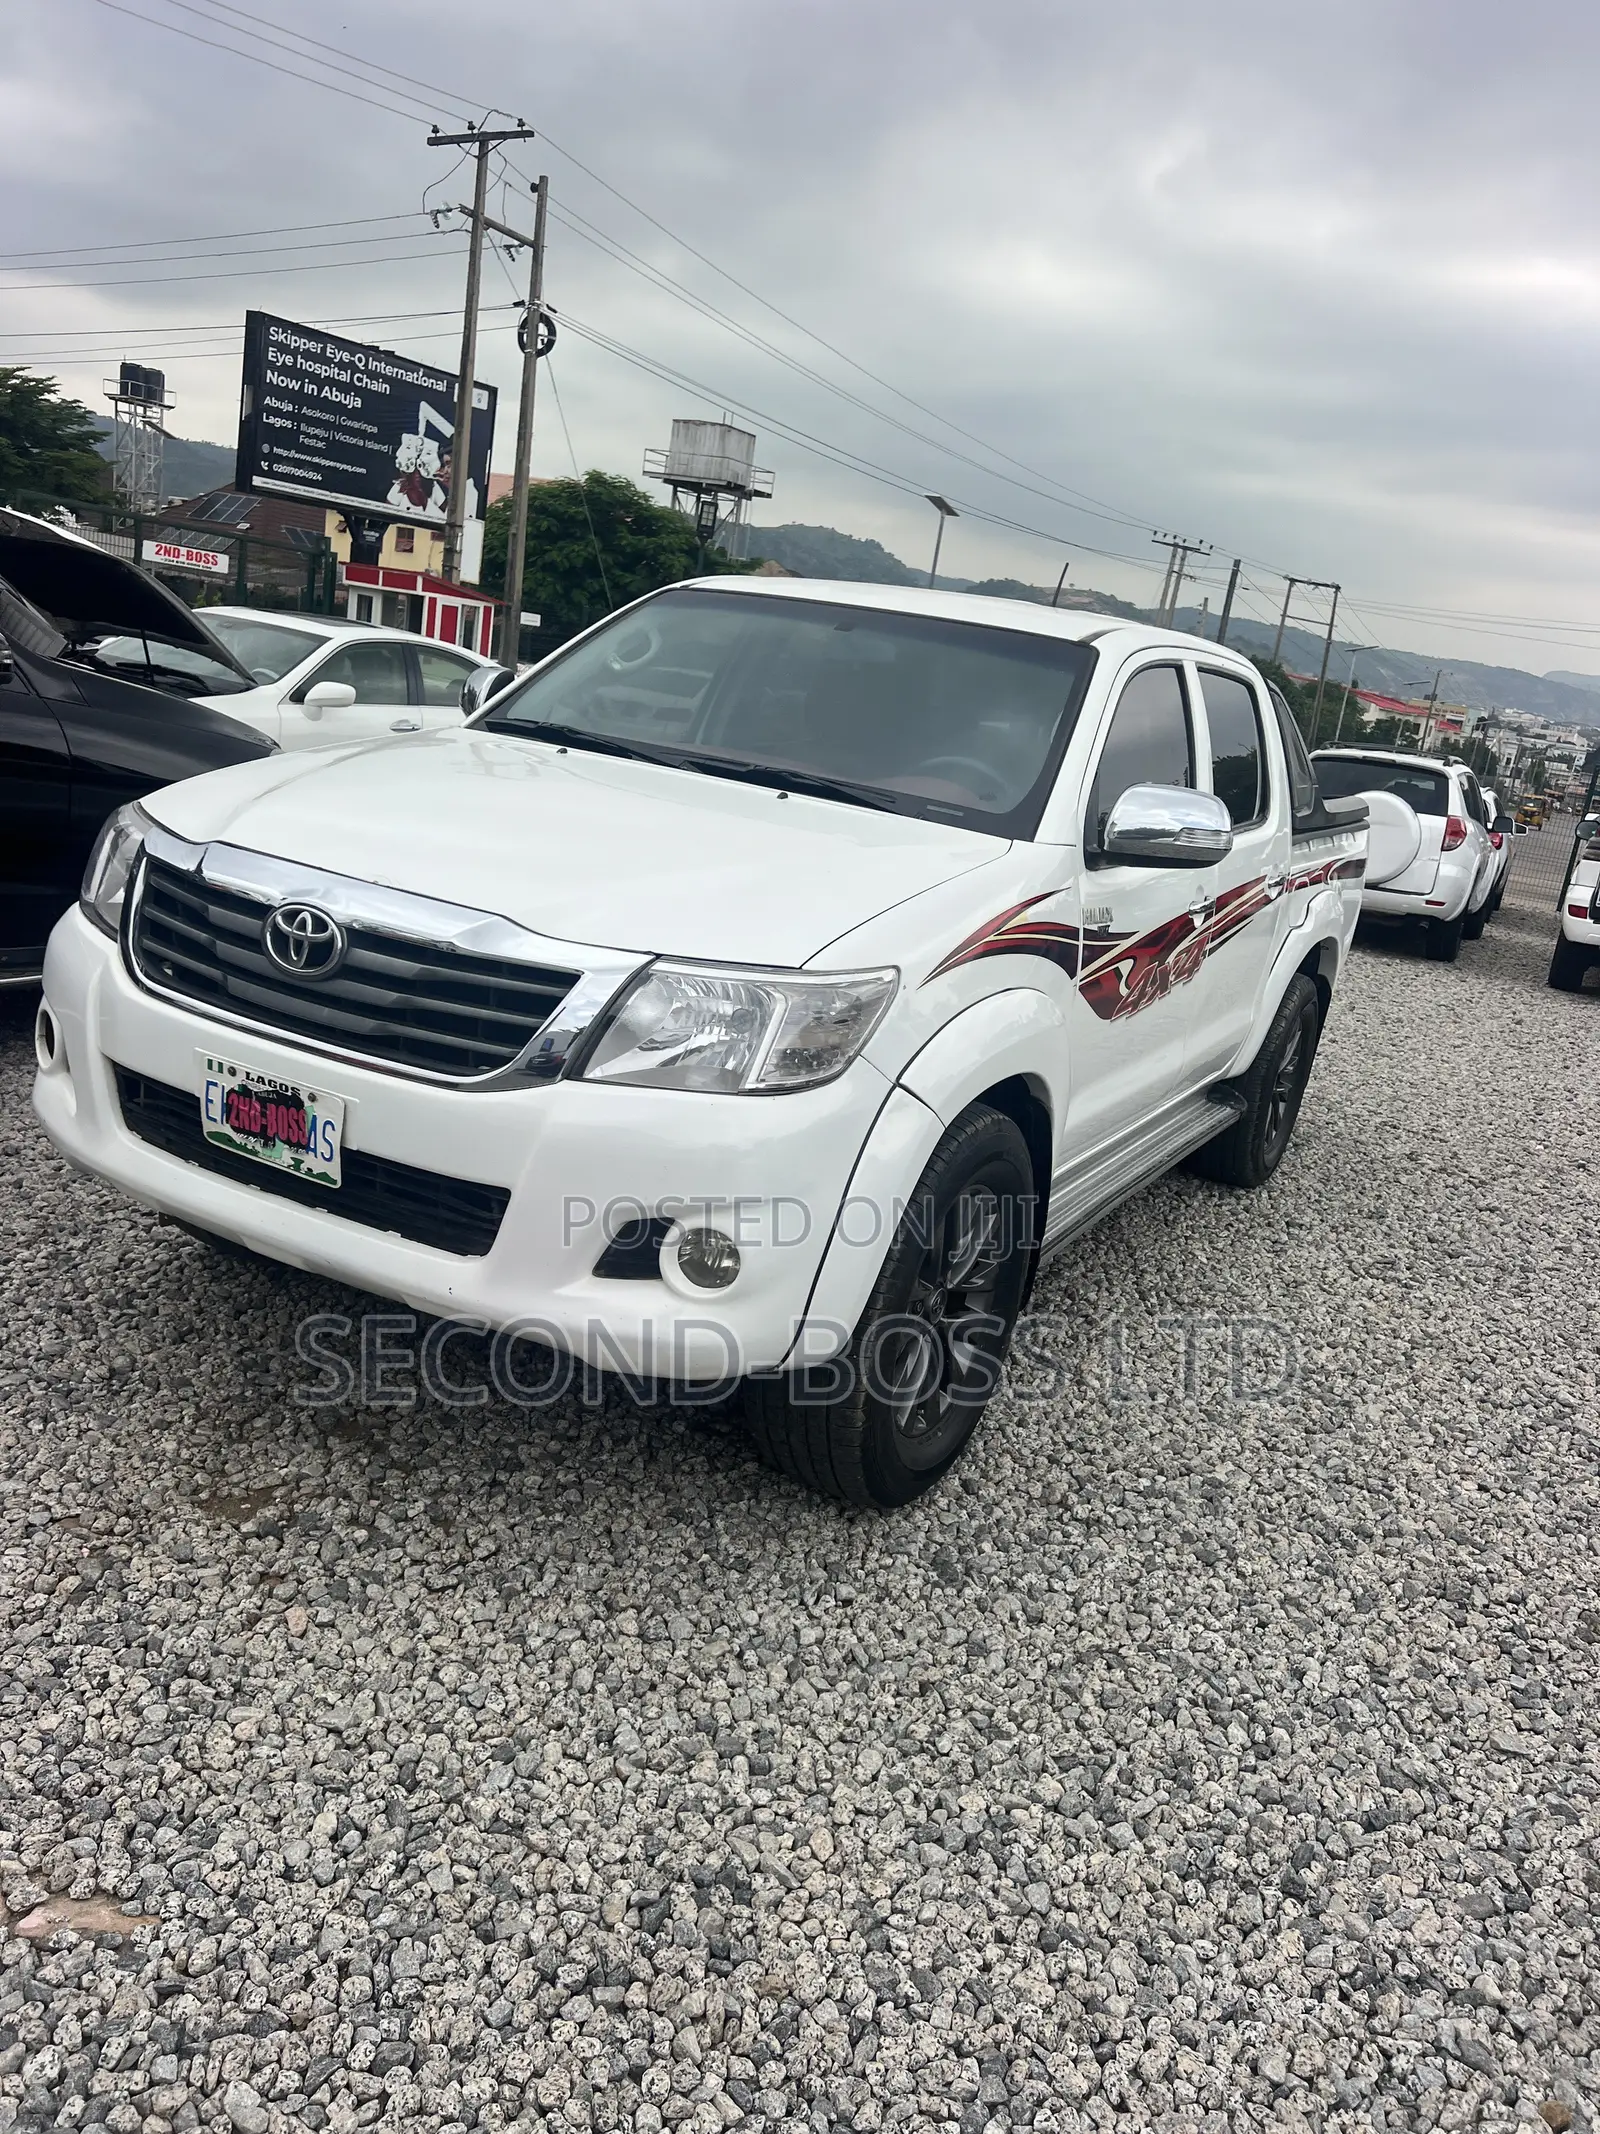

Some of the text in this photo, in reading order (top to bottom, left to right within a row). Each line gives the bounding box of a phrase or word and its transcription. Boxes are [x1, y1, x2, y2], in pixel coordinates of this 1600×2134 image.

[268, 347, 391, 395] Eye hospital Chain
[269, 326, 447, 392] Skipper Eye-Q International
[266, 370, 362, 409] Now in Abuja
[301, 406, 336, 422] Asokoro
[340, 416, 379, 434] Gwarinpa
[299, 434, 327, 449] Festac
[334, 431, 364, 447] Victoria
[365, 439, 389, 453] Island
[154, 543, 218, 566] 2ND-BOSS
[245, 1070, 301, 1096] LAGOS
[228, 1092, 309, 1147] 2ND-BOSS
